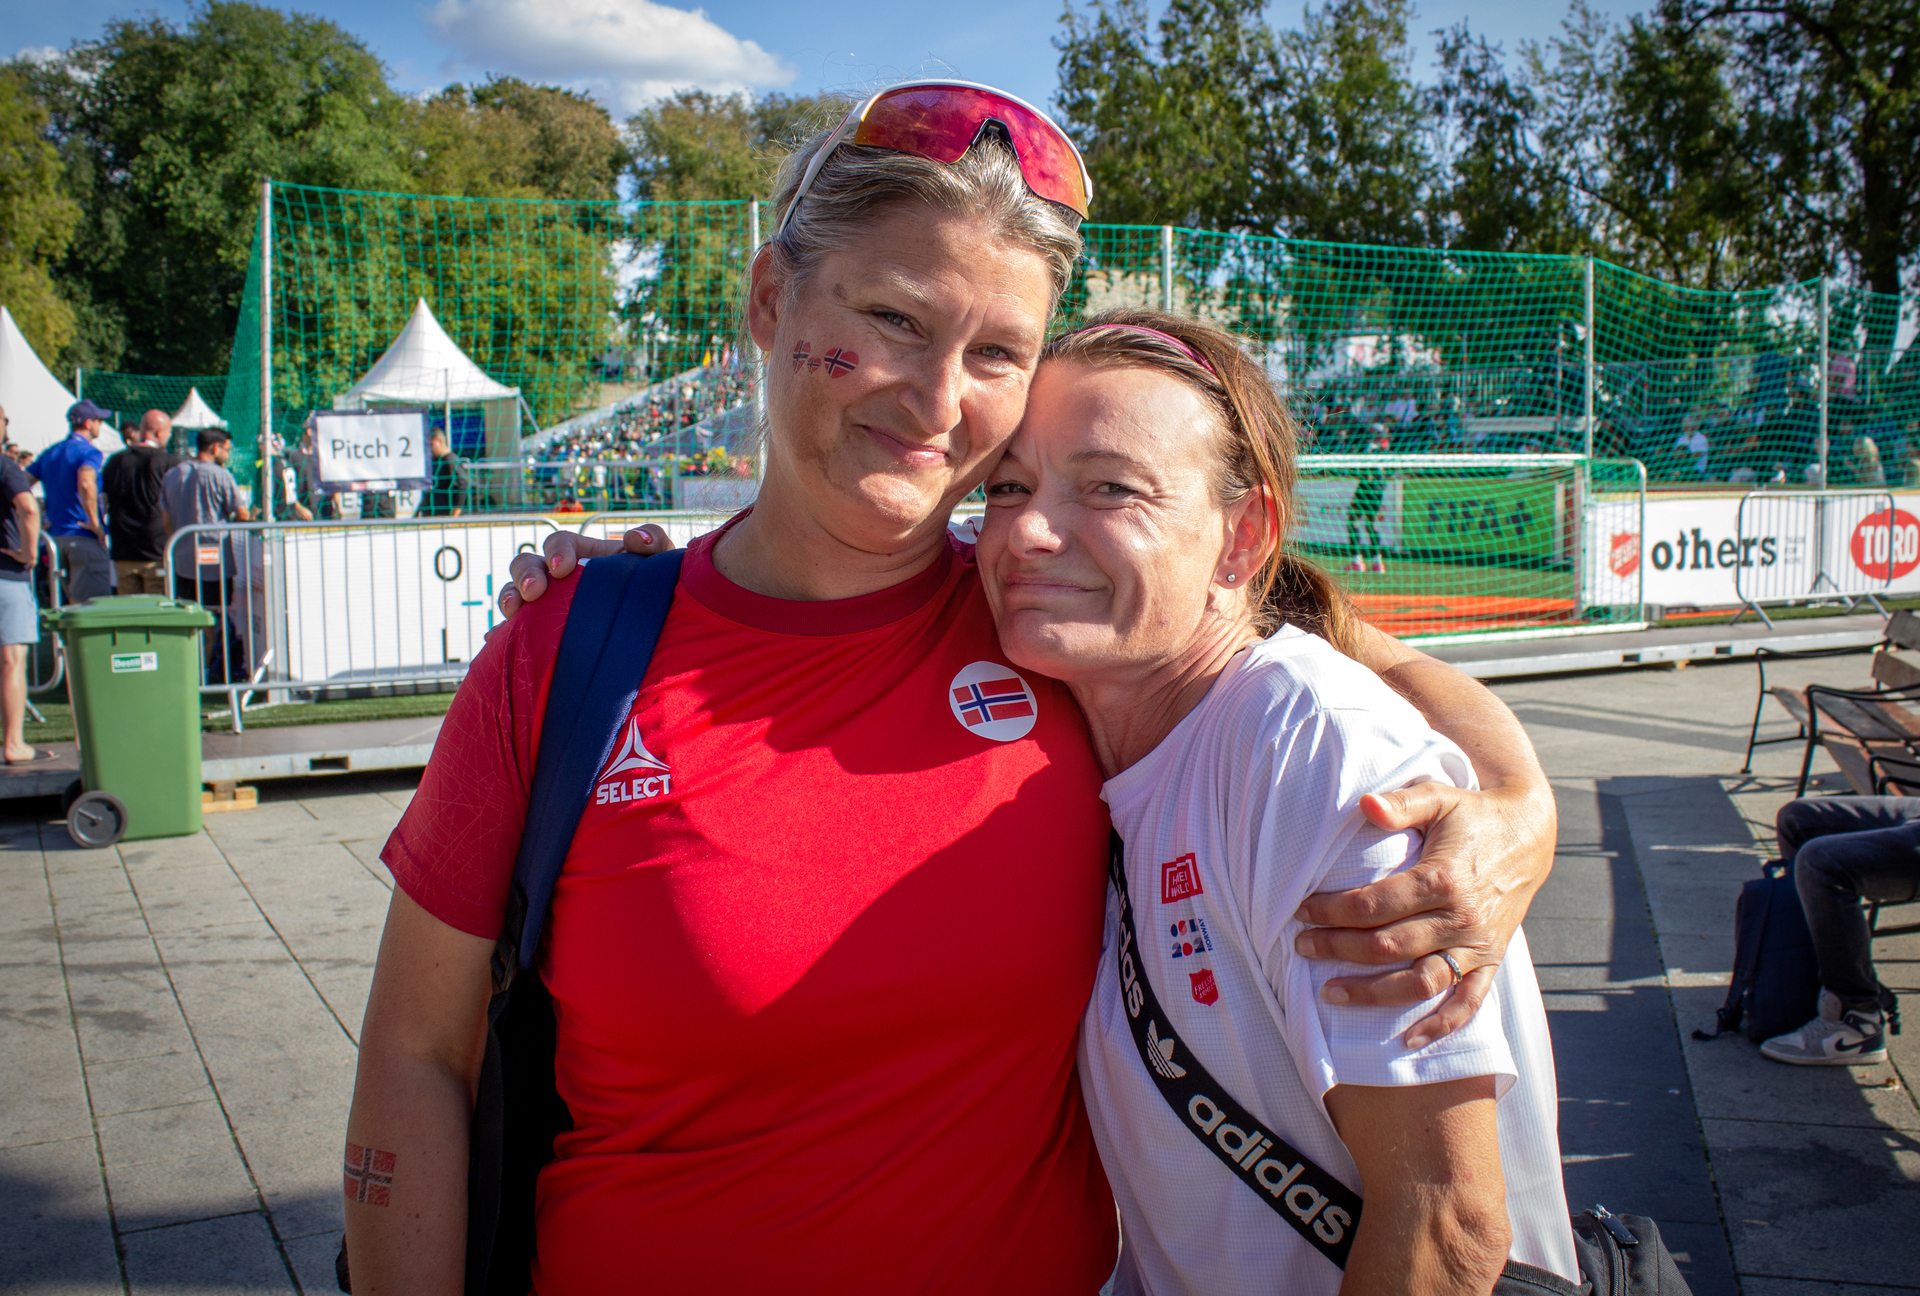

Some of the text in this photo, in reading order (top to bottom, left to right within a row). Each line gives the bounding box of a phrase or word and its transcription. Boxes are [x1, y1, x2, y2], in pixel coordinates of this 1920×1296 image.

[331, 436, 412, 459] Pitch 2
[1651, 528, 1777, 570] others
[1860, 523, 1919, 565] TORO
[596, 774, 671, 805] SELECT
[1188, 1094, 1351, 1245] adidas
